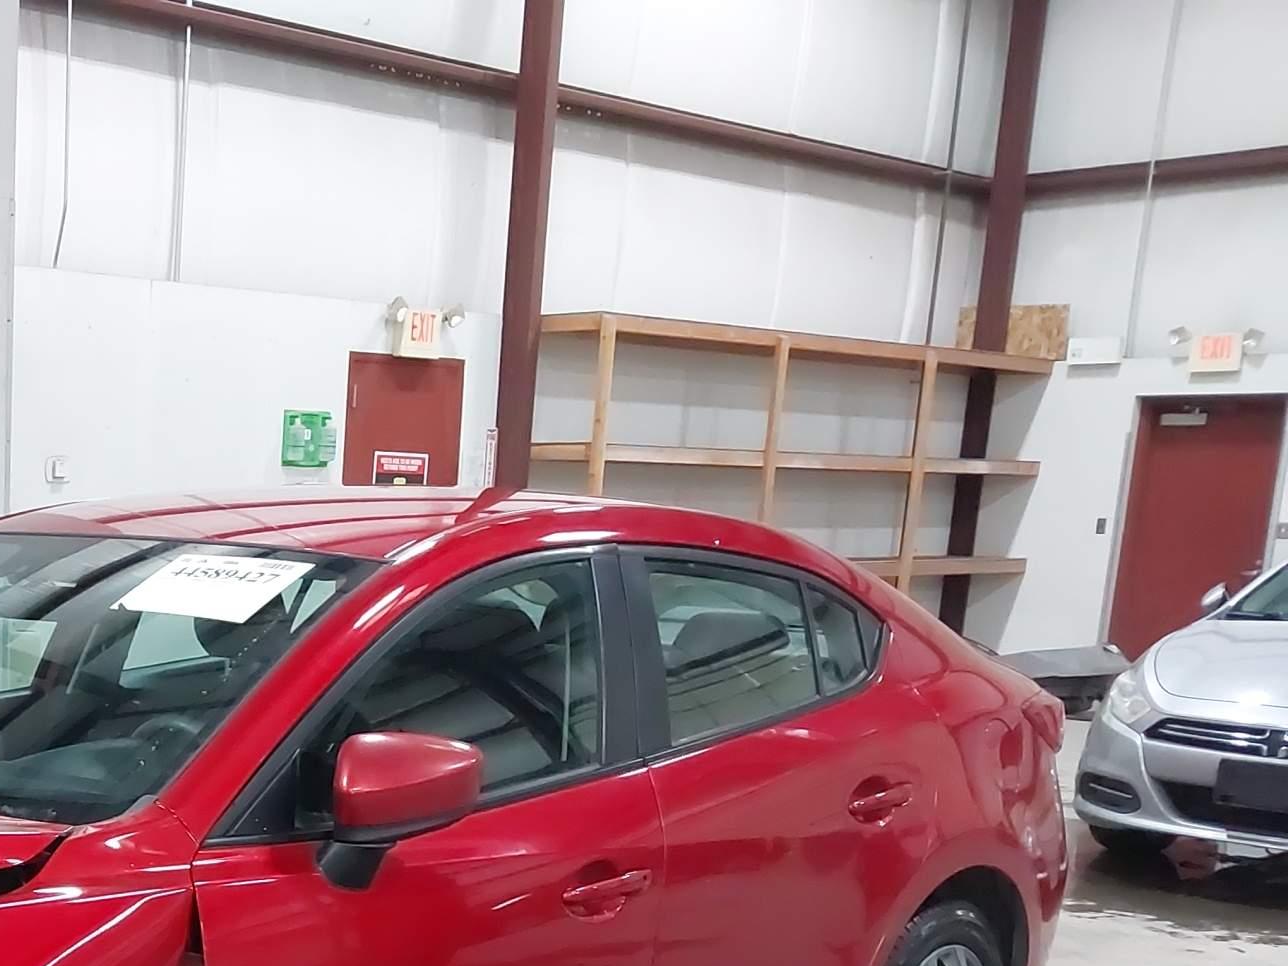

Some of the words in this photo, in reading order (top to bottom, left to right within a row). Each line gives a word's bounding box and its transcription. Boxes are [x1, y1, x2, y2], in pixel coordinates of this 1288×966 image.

[411, 311, 437, 344] EXIT
[1200, 334, 1233, 361] EXIT
[171, 566, 281, 584] 44589427
